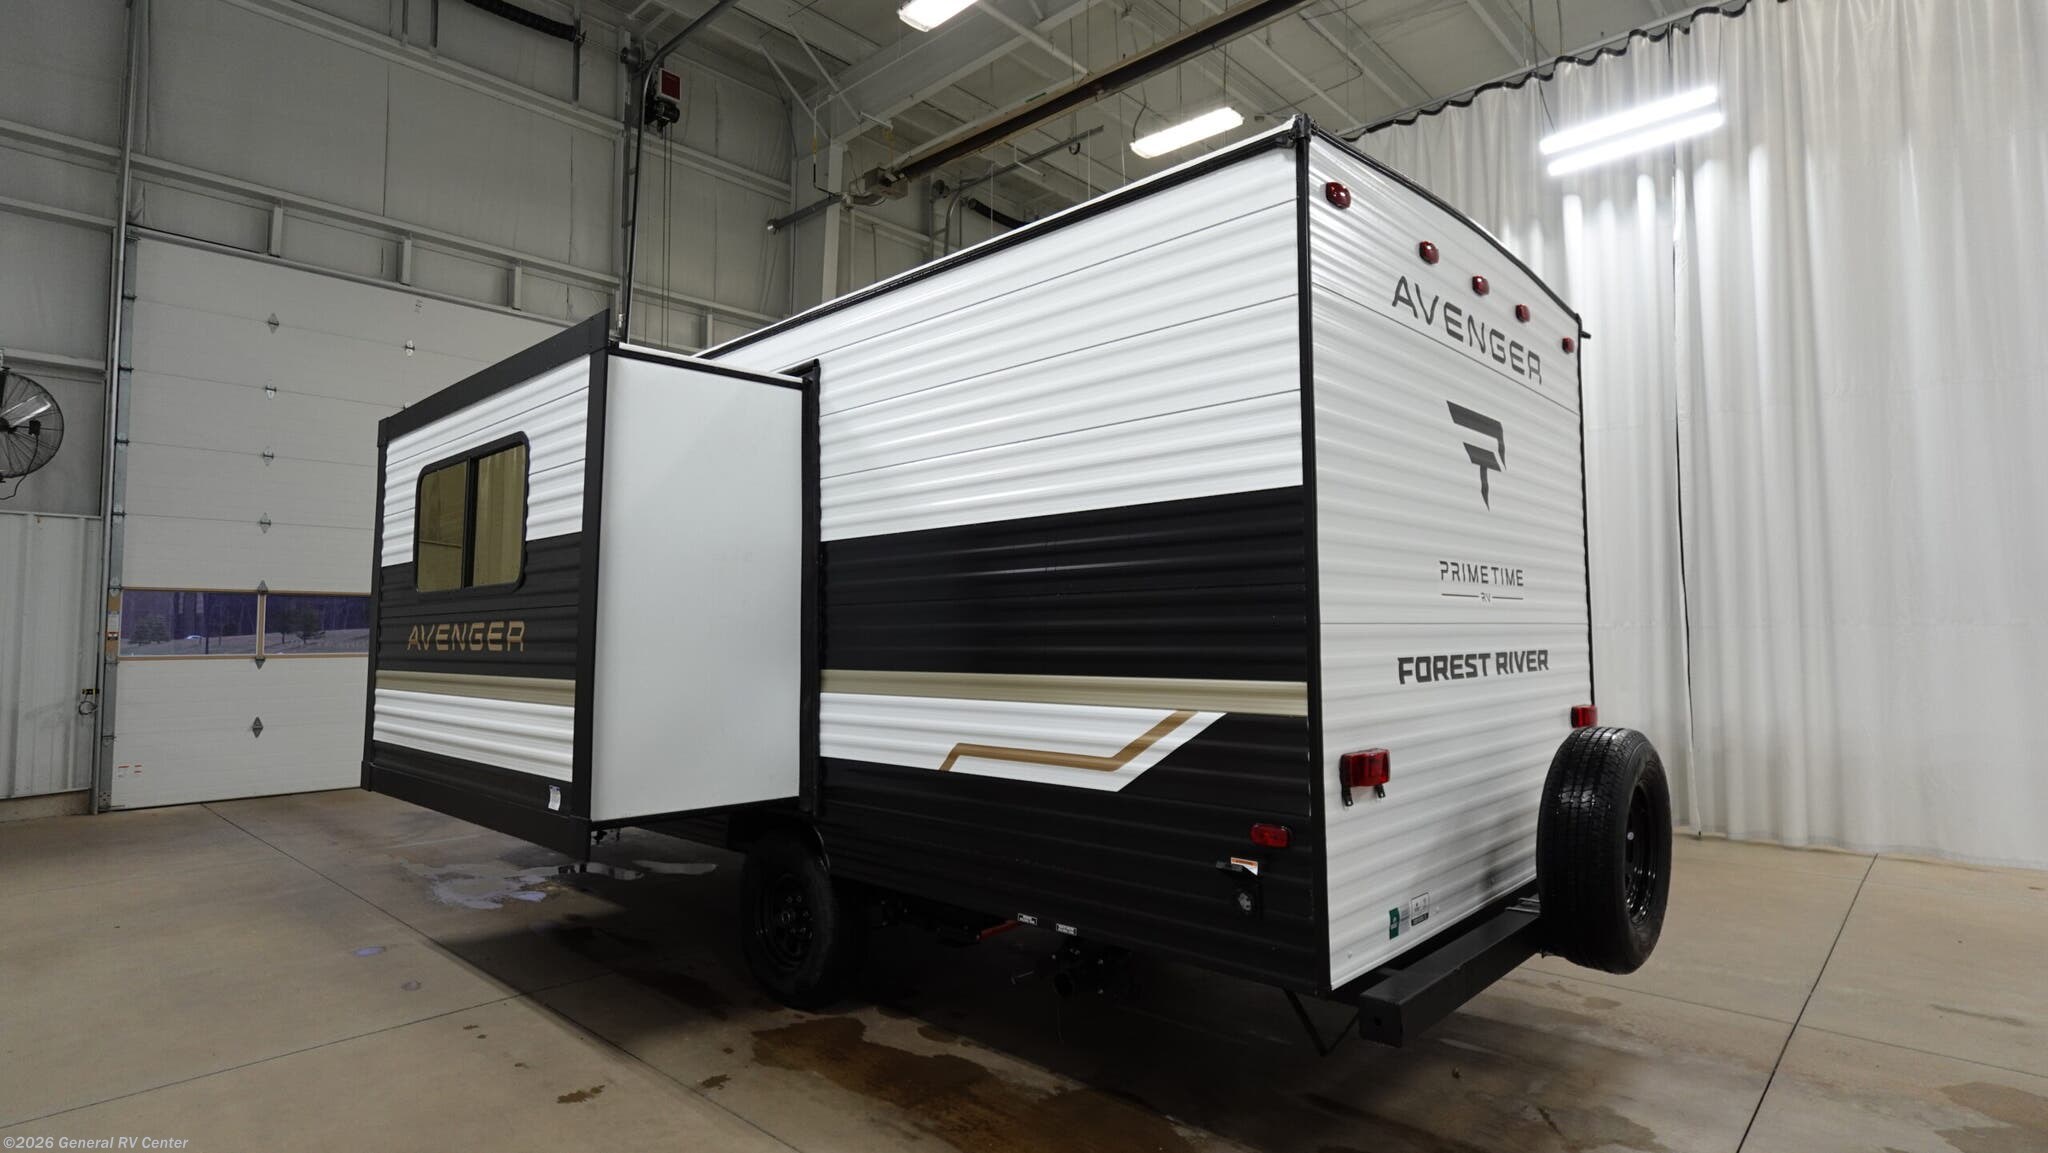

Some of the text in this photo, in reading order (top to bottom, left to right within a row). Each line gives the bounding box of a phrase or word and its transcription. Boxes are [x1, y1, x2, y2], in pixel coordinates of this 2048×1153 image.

[1392, 275, 1542, 384] AVENGER
[1480, 592, 1491, 602] RV
[407, 620, 526, 652] AVENGER
[1397, 649, 1549, 685] FOREST RIVER
